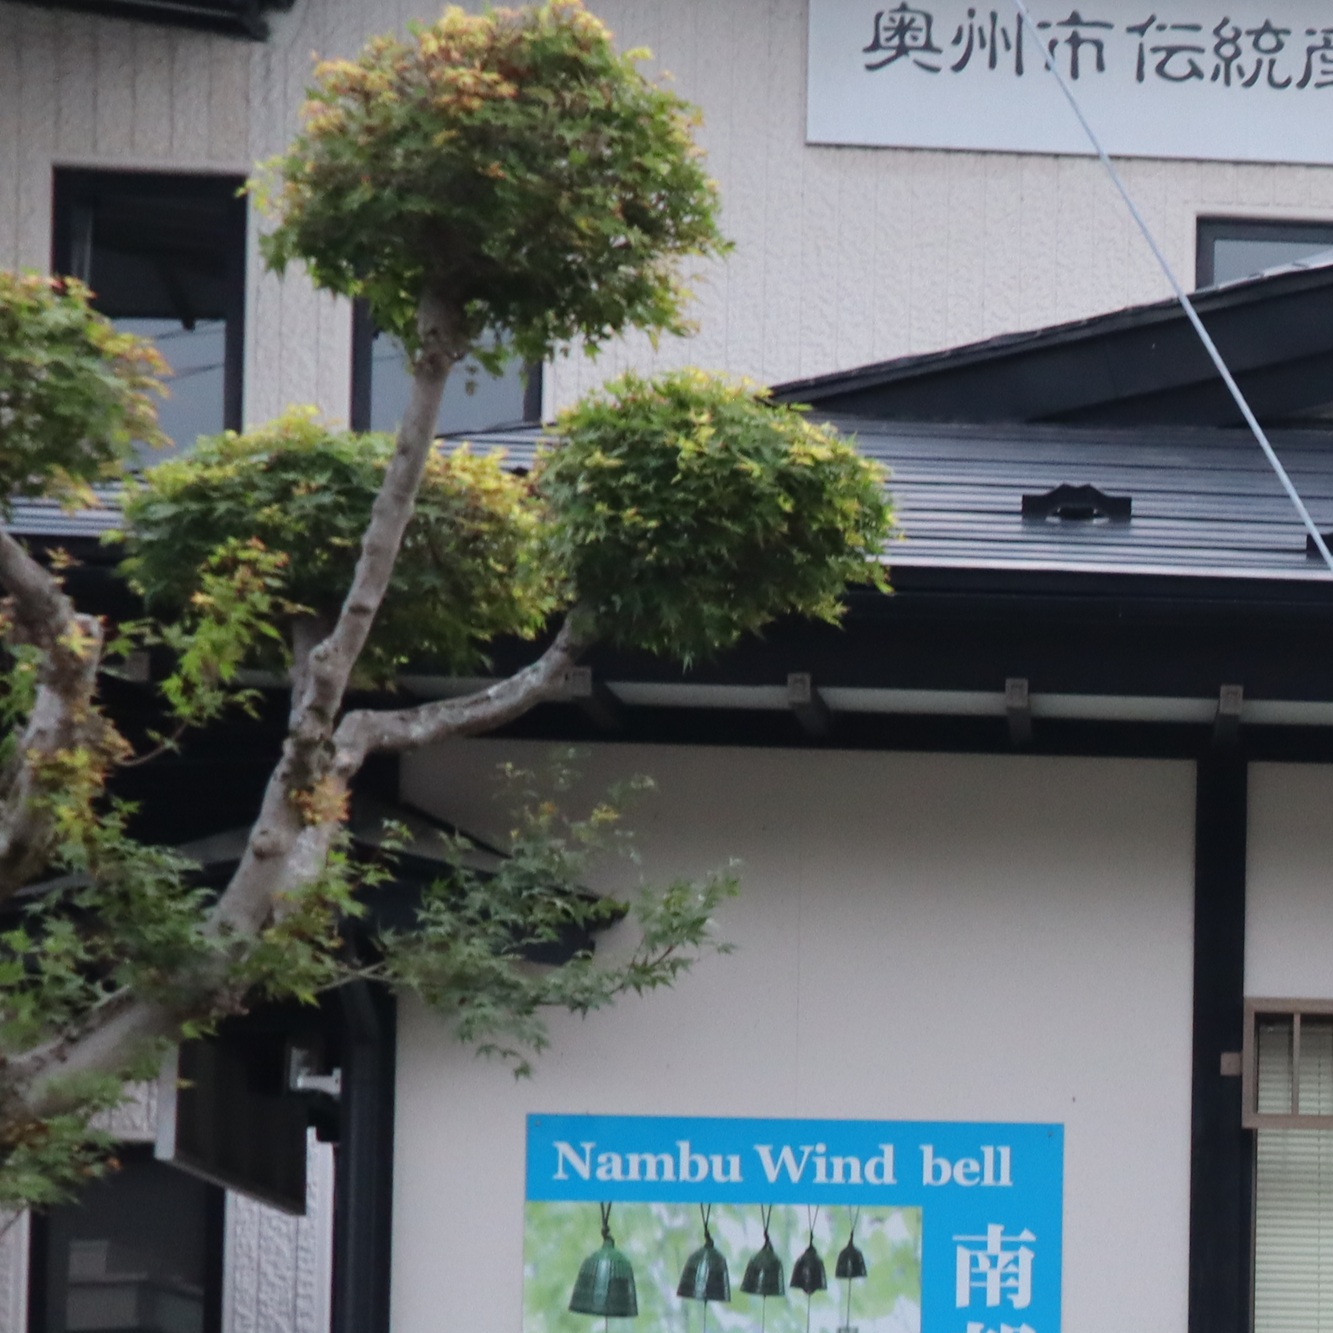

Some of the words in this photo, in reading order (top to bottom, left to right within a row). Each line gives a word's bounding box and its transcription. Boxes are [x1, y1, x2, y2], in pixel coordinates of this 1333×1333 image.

[552, 1139, 744, 1184] Nambu
[753, 1143, 898, 1186] Wind
[919, 1143, 1014, 1188] bell
